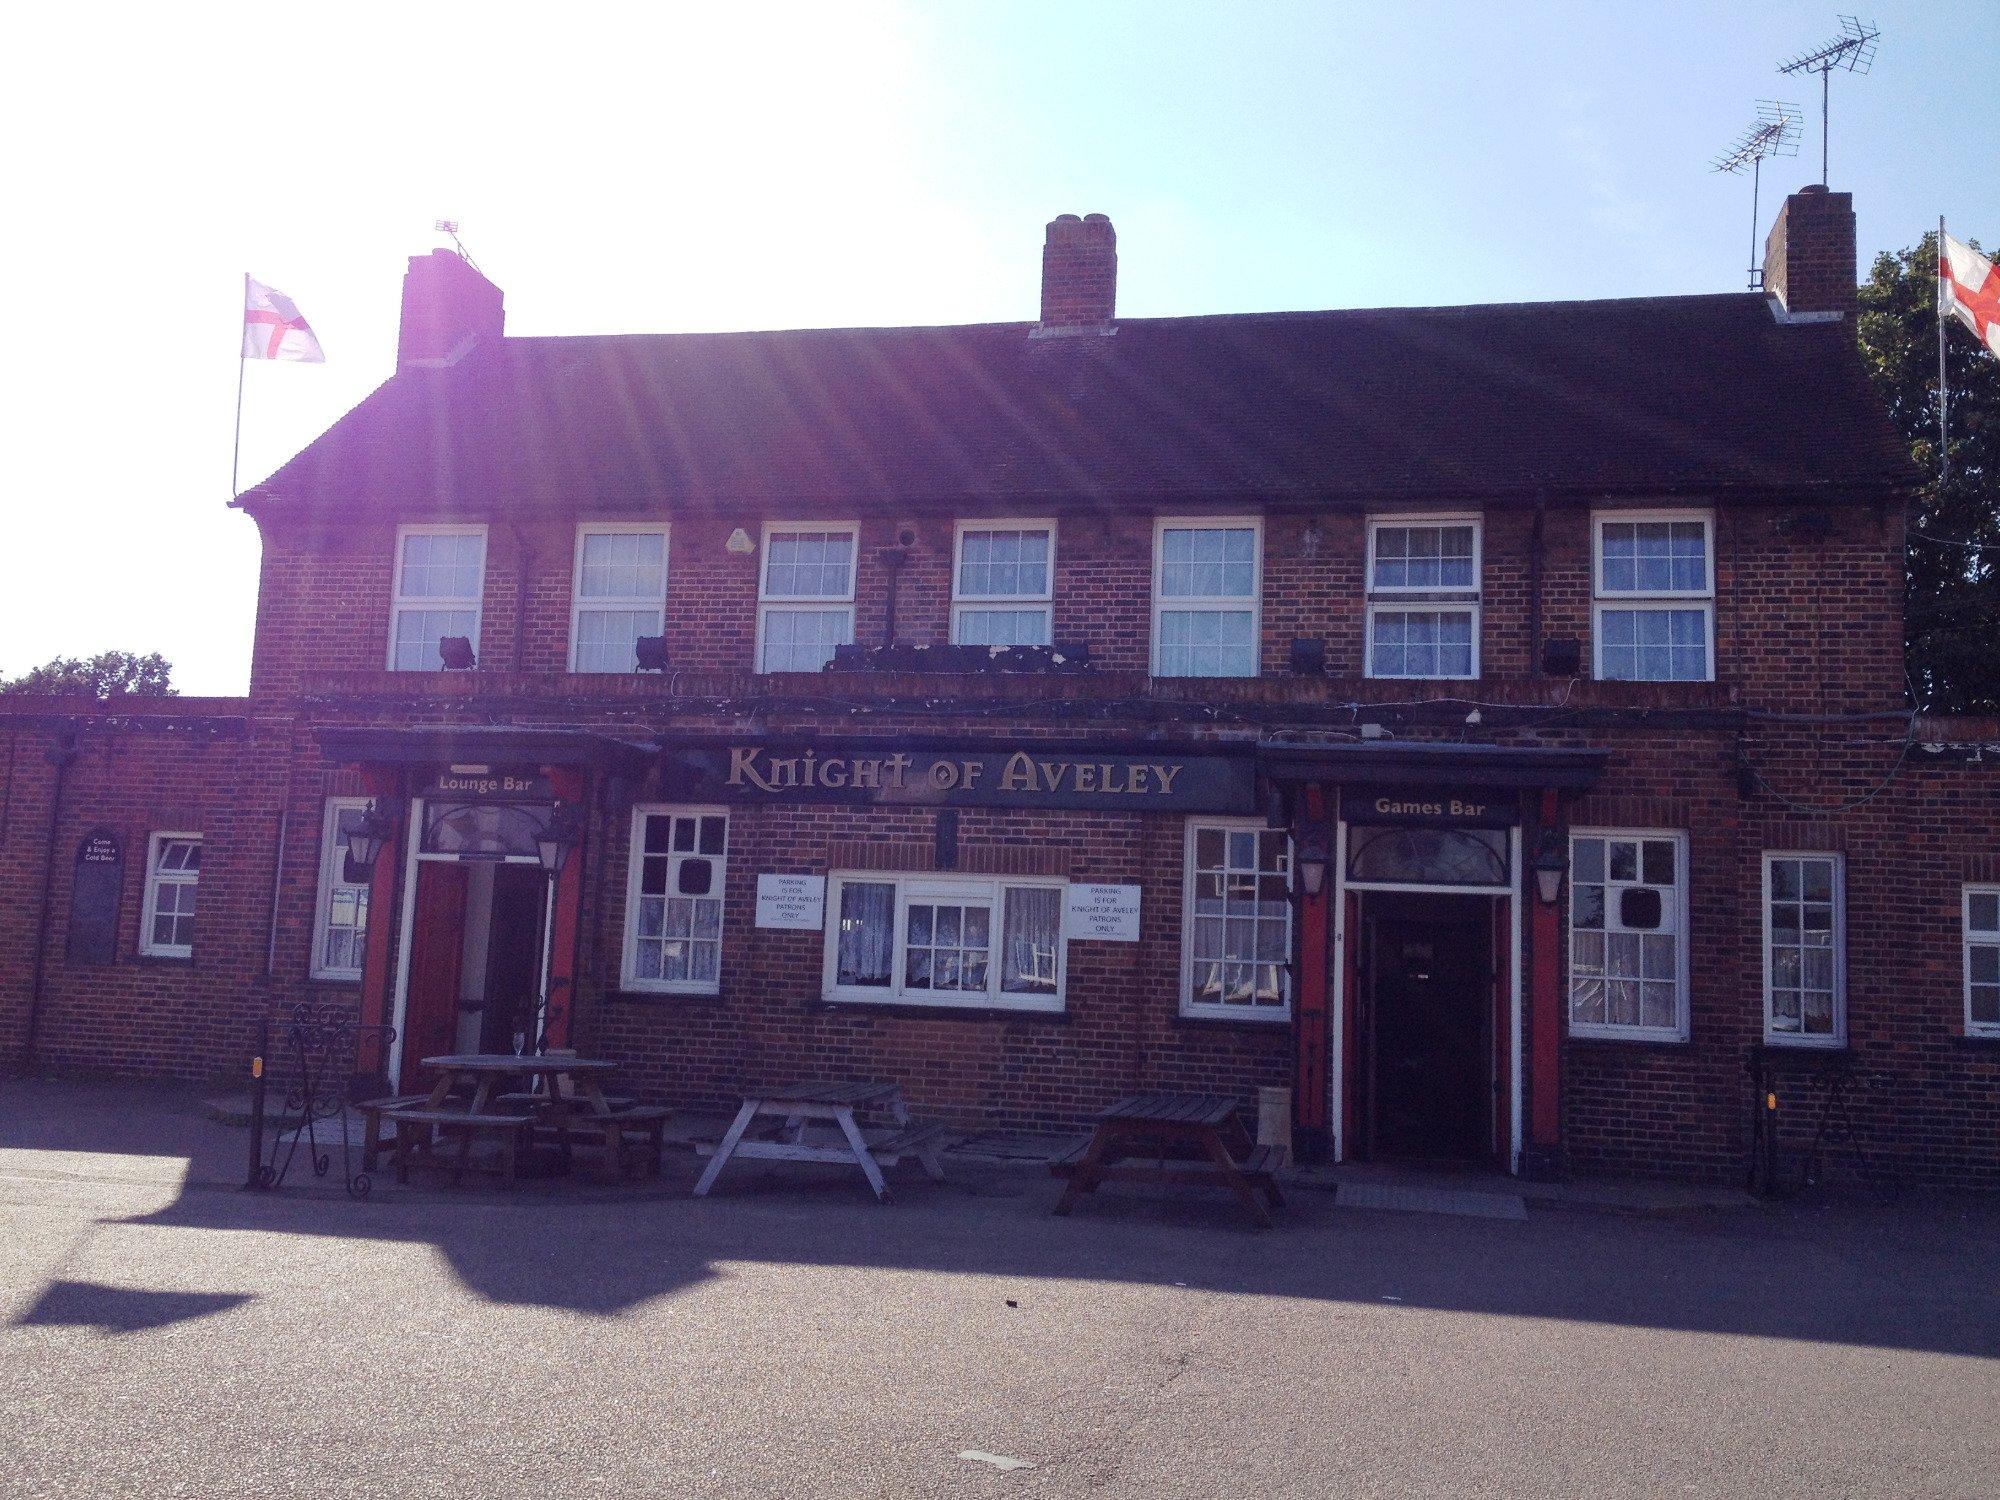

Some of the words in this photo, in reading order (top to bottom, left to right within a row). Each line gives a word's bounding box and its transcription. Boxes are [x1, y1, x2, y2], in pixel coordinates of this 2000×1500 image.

[439, 775, 498, 794] Lounge
[503, 776, 533, 791] Bar
[1375, 797, 1442, 815] Games
[1450, 799, 1486, 816] Bar
[94, 846, 110, 854] Enjoy
[778, 878, 807, 886] PARKING
[1090, 887, 1122, 895] PARKING
[1071, 905, 1099, 913] KNIGHT
[1089, 915, 1122, 923] PATRONS
